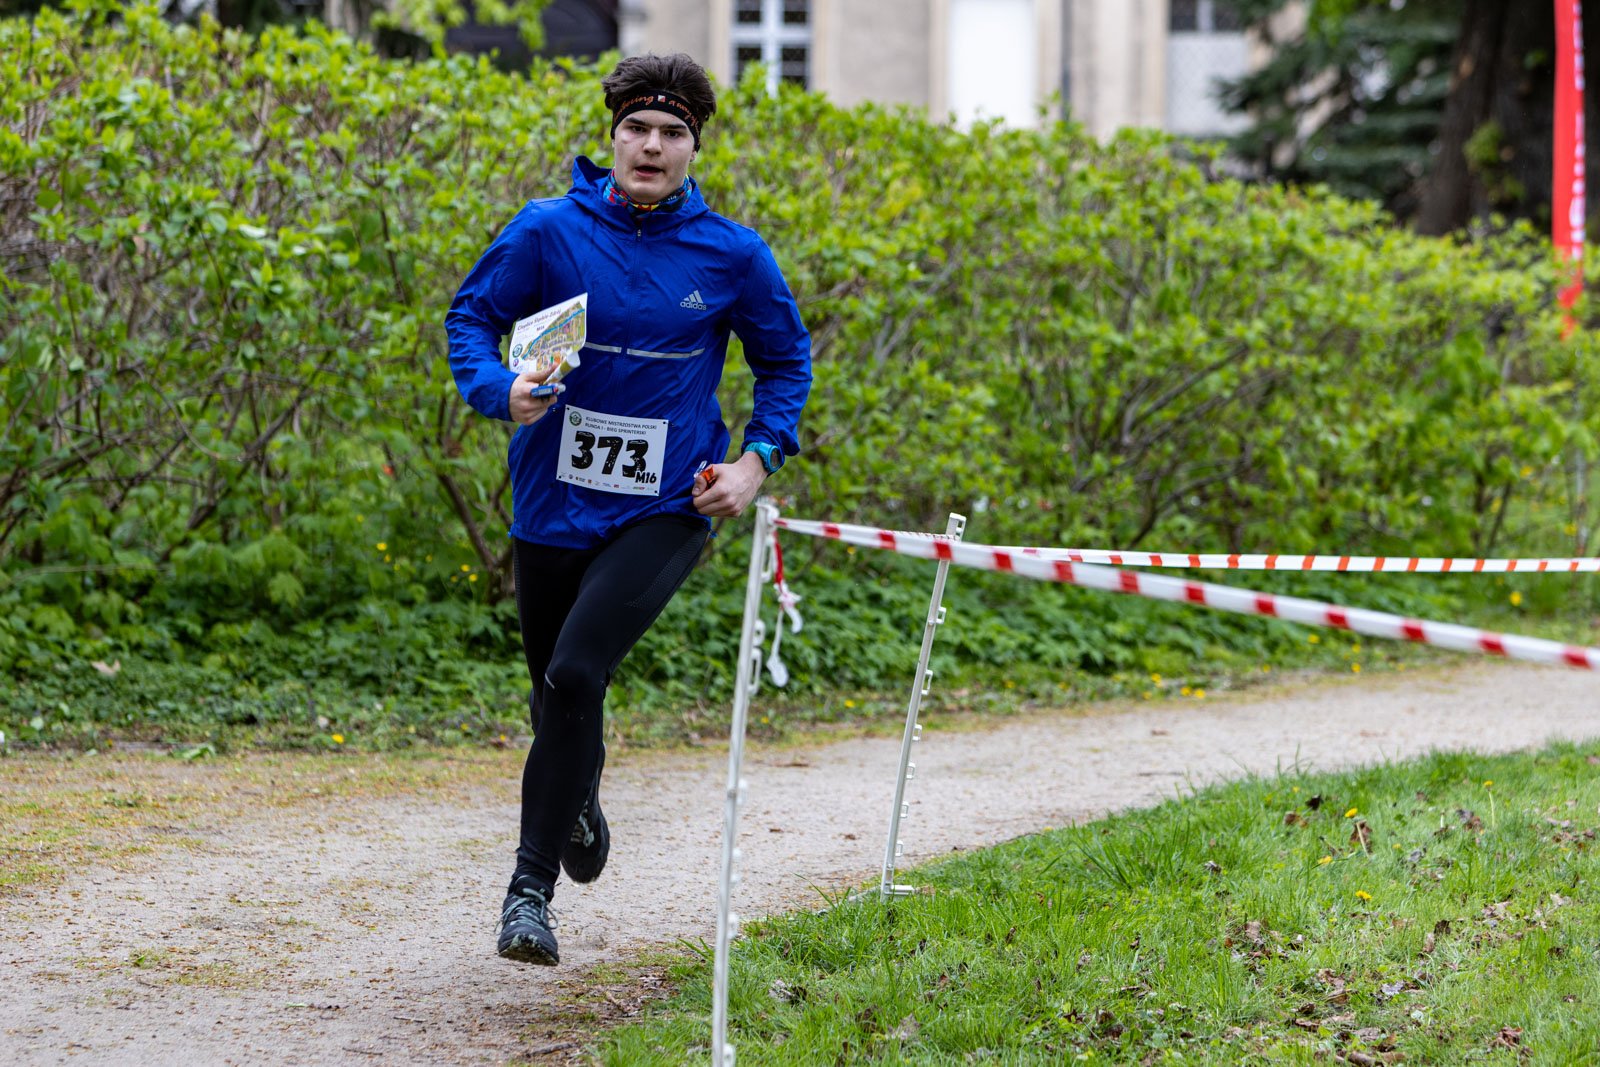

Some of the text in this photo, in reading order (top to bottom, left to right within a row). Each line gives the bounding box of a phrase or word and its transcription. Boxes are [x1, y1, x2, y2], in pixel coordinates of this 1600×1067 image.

[680, 300, 706, 310] adidas
[586, 416, 607, 425] KLUBOWE
[608, 420, 642, 428] MISTRZOSTWA
[572, 431, 648, 478] 373
[635, 472, 657, 484] M16
